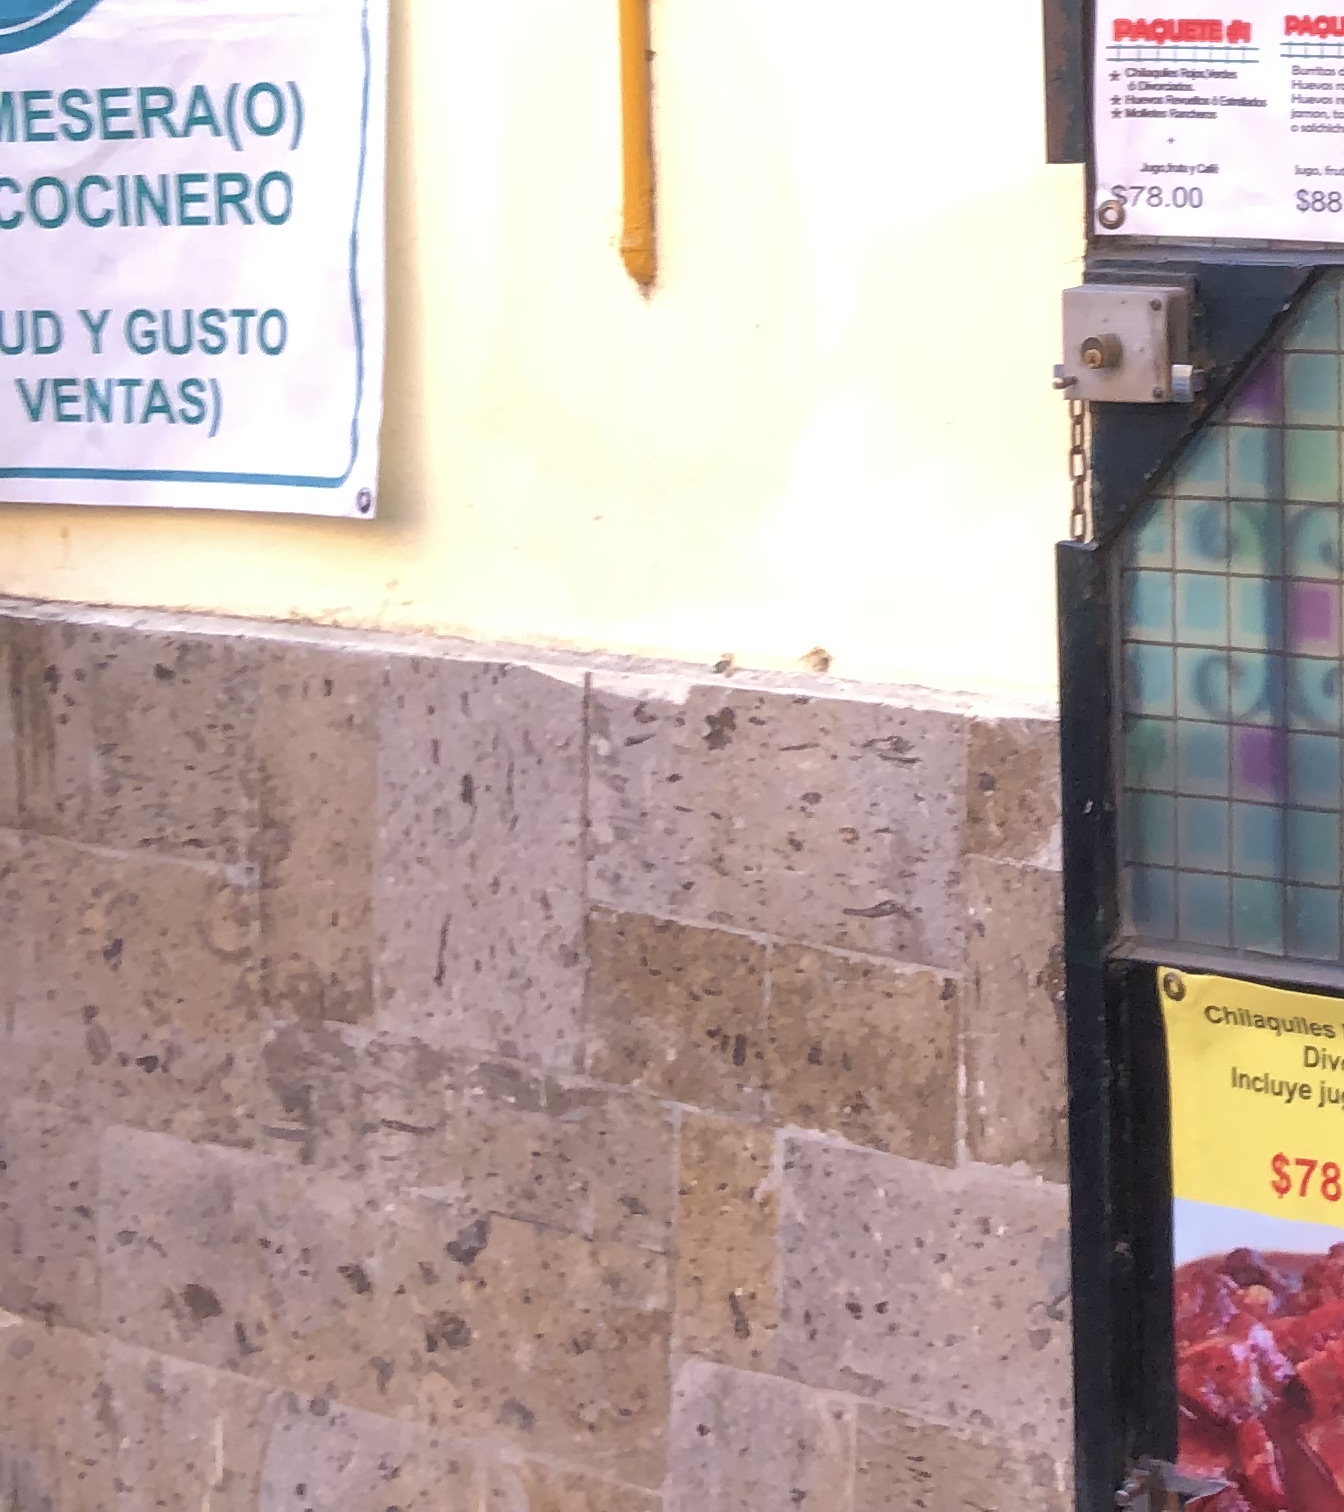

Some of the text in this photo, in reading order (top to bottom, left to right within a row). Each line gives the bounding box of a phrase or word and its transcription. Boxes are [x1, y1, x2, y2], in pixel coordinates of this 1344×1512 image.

[1113, 18, 1223, 45] PAQUETE
[0, 81, 305, 151] ESERA(O)
[0, 170, 293, 230] COCINERO
[1111, 185, 1203, 209] $78.00
[76, 308, 113, 354] Y
[124, 307, 287, 355] GUSTO
[14, 378, 223, 438] VENTAS)
[1203, 1005, 1336, 1038] Chilaquiles
[1231, 1065, 1312, 1104] Incluye
